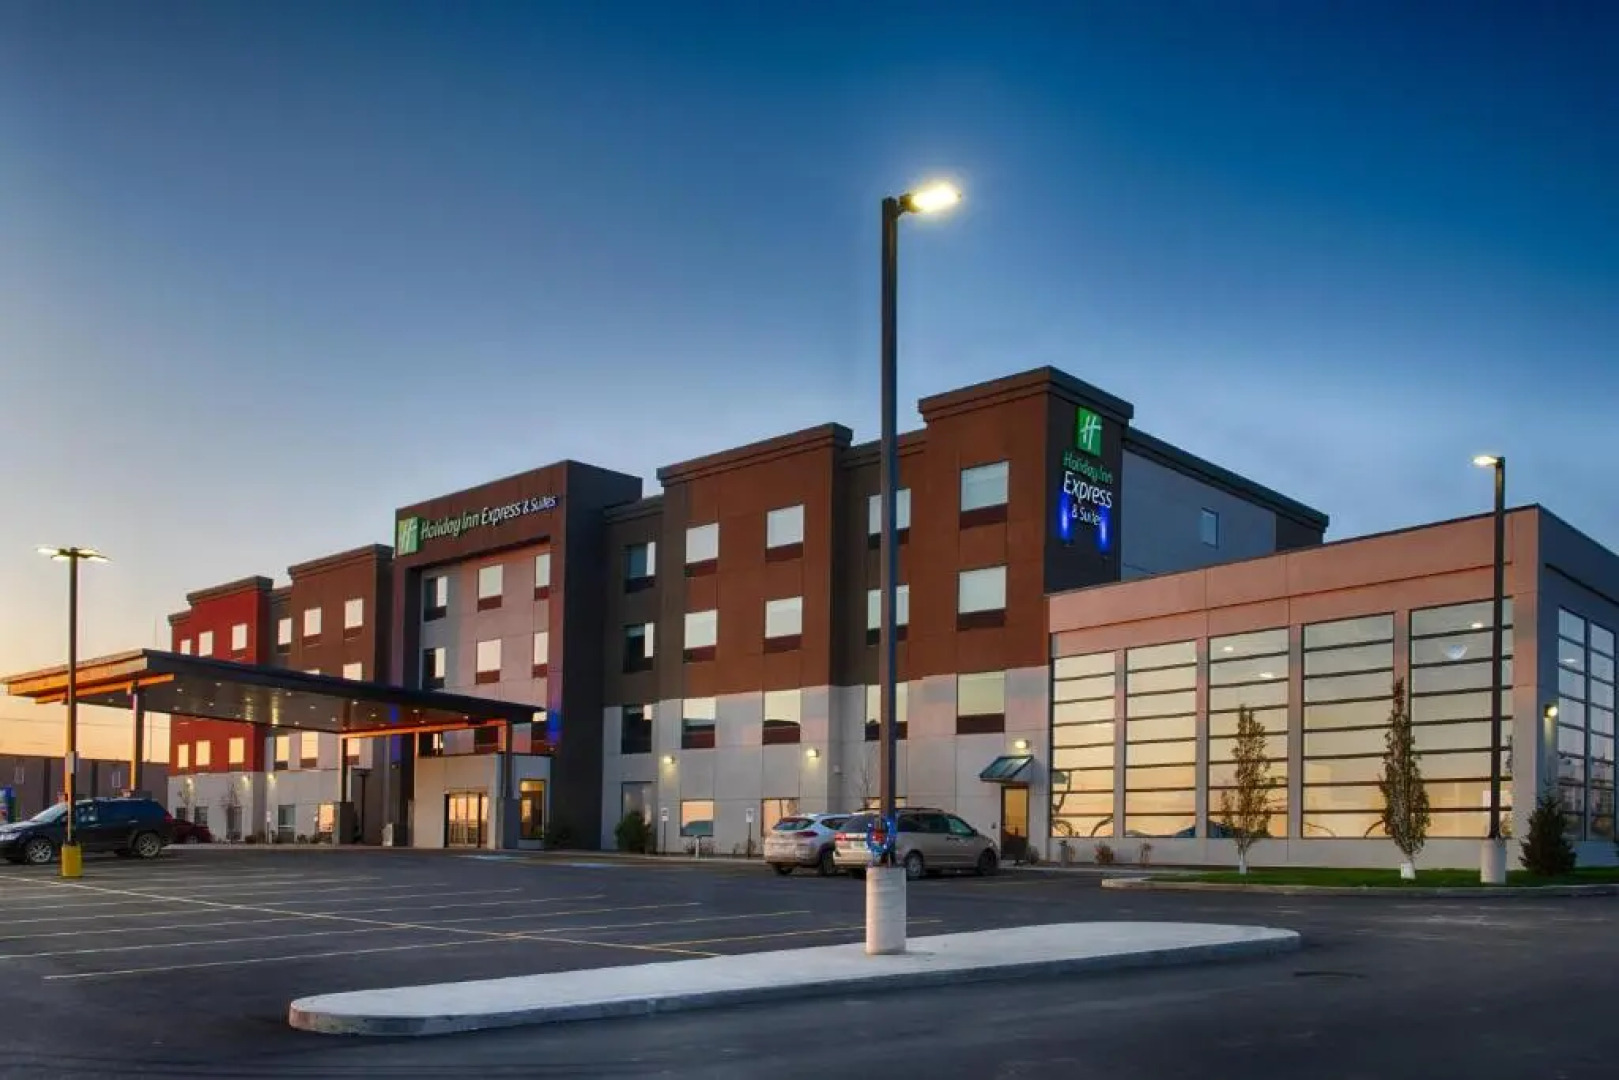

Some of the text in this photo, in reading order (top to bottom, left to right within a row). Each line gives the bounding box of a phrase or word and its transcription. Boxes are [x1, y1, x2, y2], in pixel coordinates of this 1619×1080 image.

[1063, 452, 1113, 484] Holiday Inn
[1063, 471, 1113, 508] Express
[421, 517, 460, 540] Holiday
[461, 511, 480, 529] Inn
[481, 503, 521, 525] Express
[522, 502, 529, 514] &
[1071, 505, 1107, 526] & Suite
